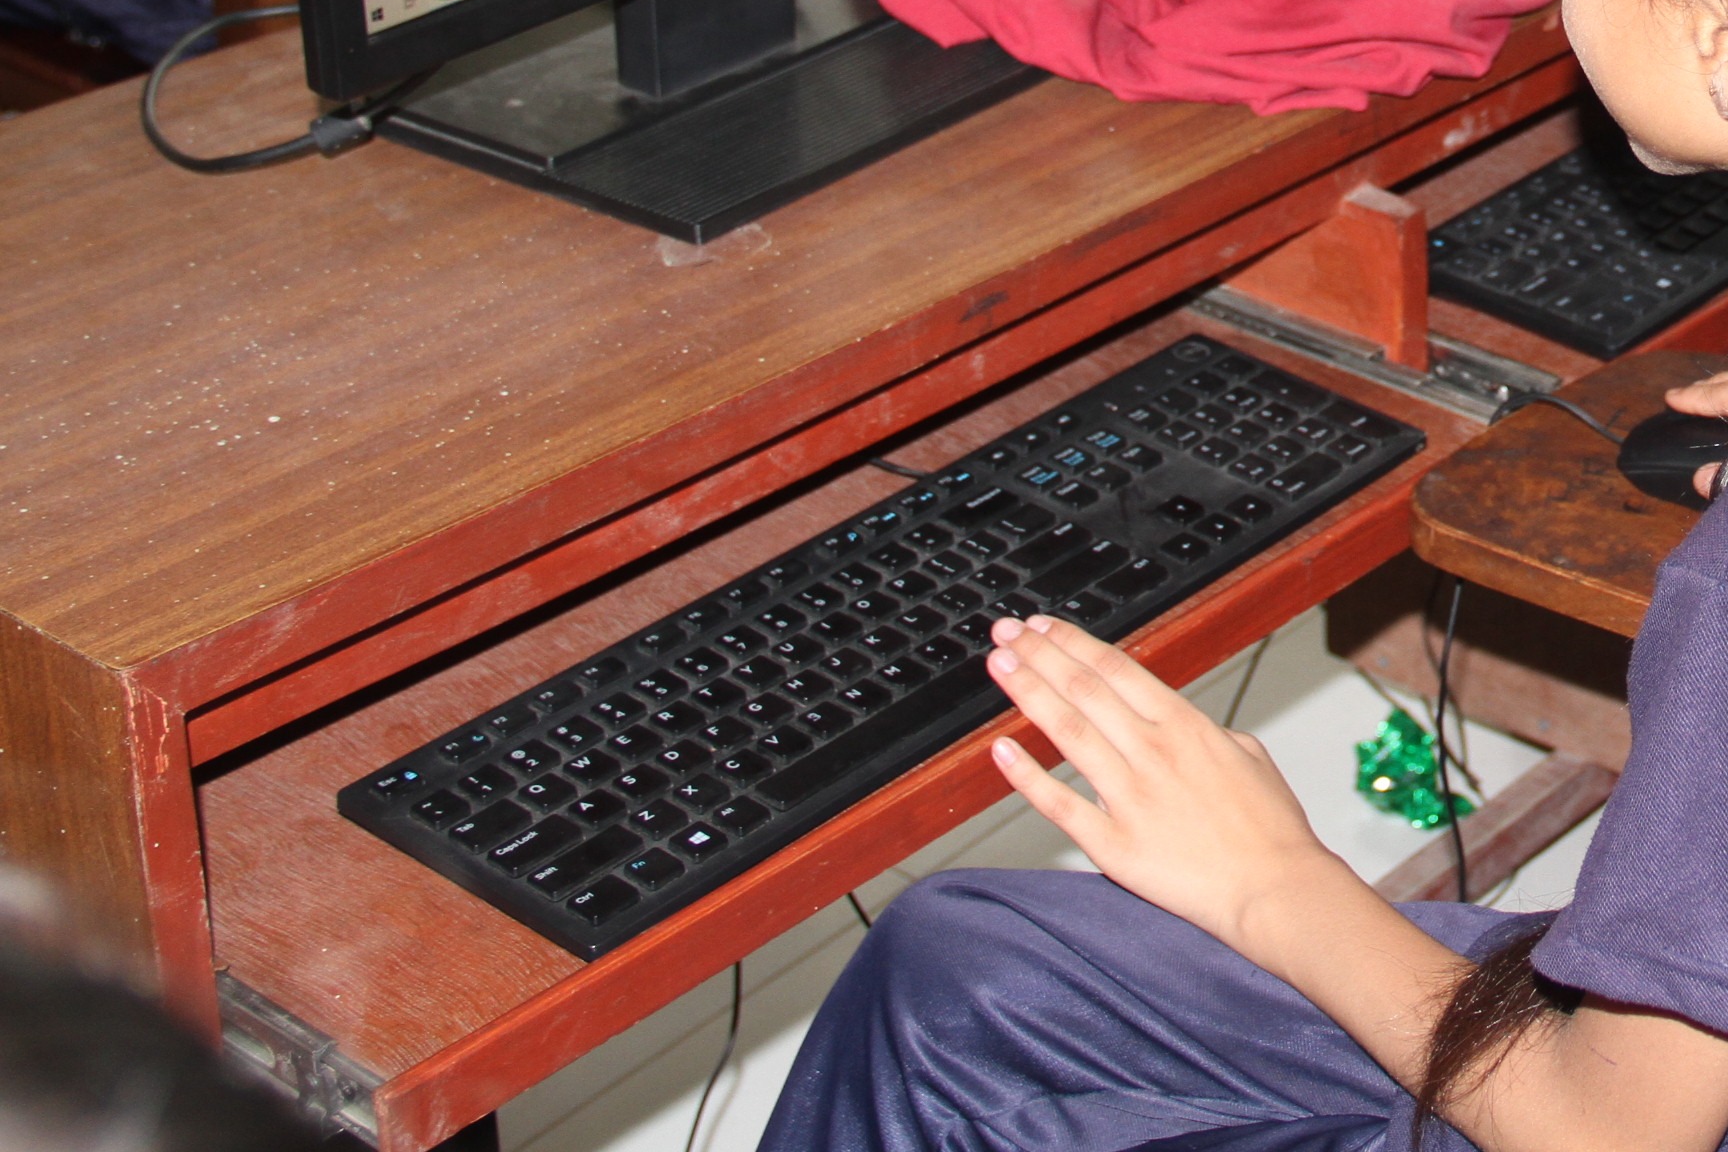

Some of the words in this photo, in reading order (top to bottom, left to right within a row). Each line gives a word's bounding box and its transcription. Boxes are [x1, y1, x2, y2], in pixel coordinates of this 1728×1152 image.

[856, 600, 871, 609] O
[865, 635, 881, 645] K
[779, 642, 795, 653] U
[739, 665, 753, 674] Y
[883, 665, 901, 676] M
[787, 679, 804, 690] H
[698, 687, 713, 696] T
[845, 688, 862, 699] N
[748, 702, 763, 712] G
[657, 711, 674, 721] R
[706, 726, 719, 736] F
[615, 735, 632, 745] E
[764, 735, 779, 744] V
[663, 750, 680, 761] D
[526, 758, 540, 767] 2
[571, 756, 591, 769] W
[725, 760, 741, 769] C
[377, 776, 398, 788] Esc
[621, 775, 637, 785] S
[528, 784, 546, 794] Q
[681, 784, 699, 796] X
[579, 802, 594, 811] A
[638, 810, 656, 821] Z
[720, 807, 735, 817] Alt
[455, 822, 475, 833] Tab
[495, 842, 518, 856] Caps
[517, 830, 539, 845] Lock
[631, 860, 646, 870] Fn
[534, 866, 559, 881] Shift
[575, 892, 595, 904] Ctrl
